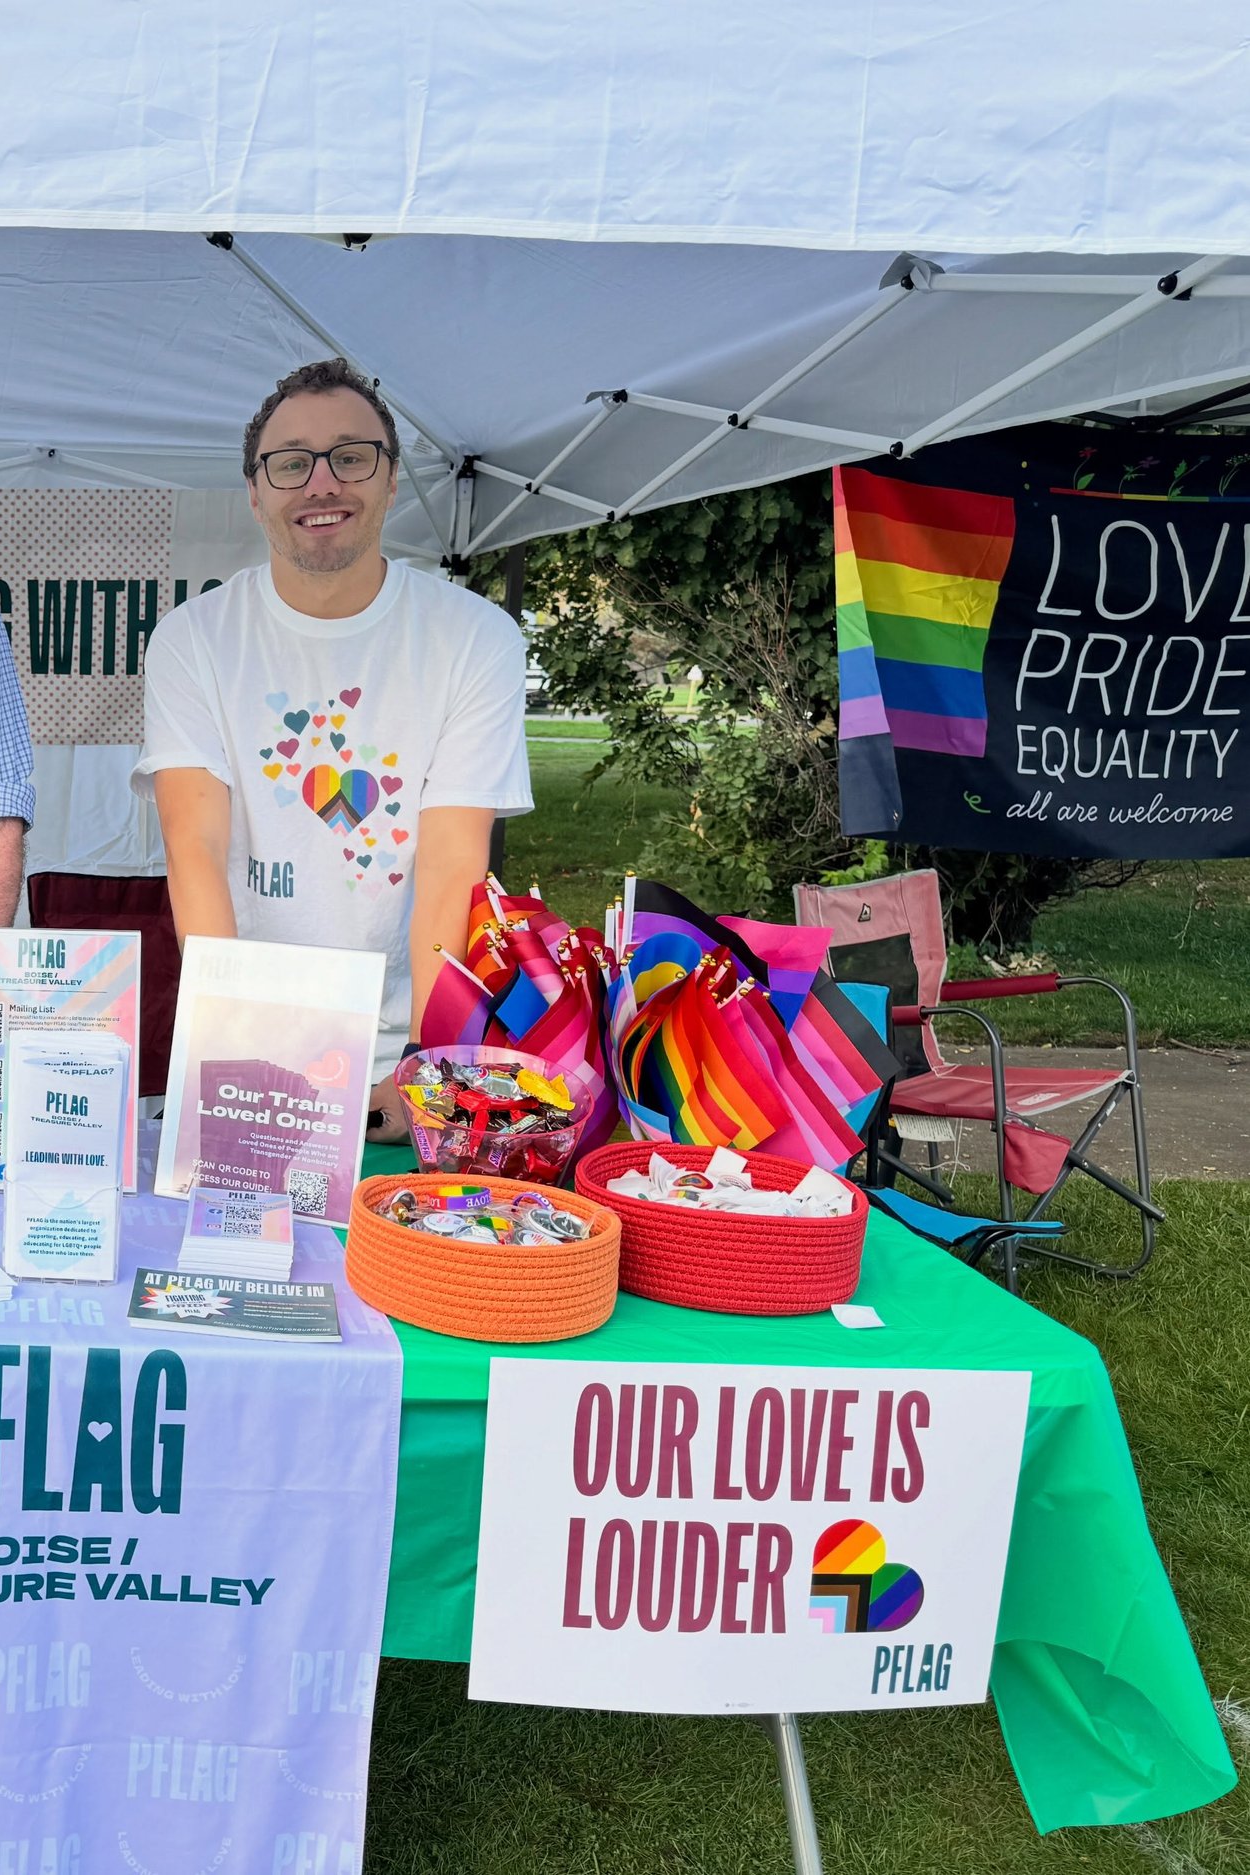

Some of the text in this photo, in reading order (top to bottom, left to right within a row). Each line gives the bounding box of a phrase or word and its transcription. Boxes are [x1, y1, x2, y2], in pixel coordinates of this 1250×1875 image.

[27, 579, 158, 676] WITH
[1015, 628, 1250, 717] PRIDE
[1016, 724, 1240, 784] EQUALITY
[1006, 790, 1233, 824] all are welcome
[247, 854, 294, 898] PFLAG
[18, 938, 66, 969] PFLAG
[0, 977, 48, 985] TREASURE
[9, 1004, 38, 1014] Mailing
[46, 1091, 88, 1116] PFLAG
[218, 1084, 345, 1116] Our Trans
[30, 1116, 72, 1126] TREASURE
[197, 1100, 342, 1135] Loved Ones
[238, 1138, 258, 1146] Loved
[286, 1146, 309, 1155] People
[250, 1132, 283, 1142] Questions
[299, 1141, 328, 1150] Answers
[414, 1126, 432, 1160] SNICKERS
[26, 1151, 59, 1164] LEADING
[62, 1153, 84, 1165] WITH
[192, 1159, 270, 1179] SCAN QR CODE TO
[250, 1148, 291, 1160] Transgender
[302, 1157, 338, 1168] Nonbinary
[222, 1178, 241, 1188] OUR
[229, 1192, 256, 1200] PFLAG
[144, 1272, 325, 1297] AT PFLAG WE BELIEVE IN
[165, 1294, 206, 1302] FIGHTING
[572, 1382, 931, 1504] OUR LOVE IS
[121, 1537, 140, 1566] /
[85, 1573, 275, 1607] VALLEY
[562, 1517, 793, 1634] LOUDER
[130, 1646, 247, 1702] LEADING WITH LOVE
[871, 1643, 953, 1695] PFLAG
[28, 1781, 70, 1804] WITH
[69, 1743, 92, 1782] LOVE
[127, 1735, 239, 1802] PFLAG
